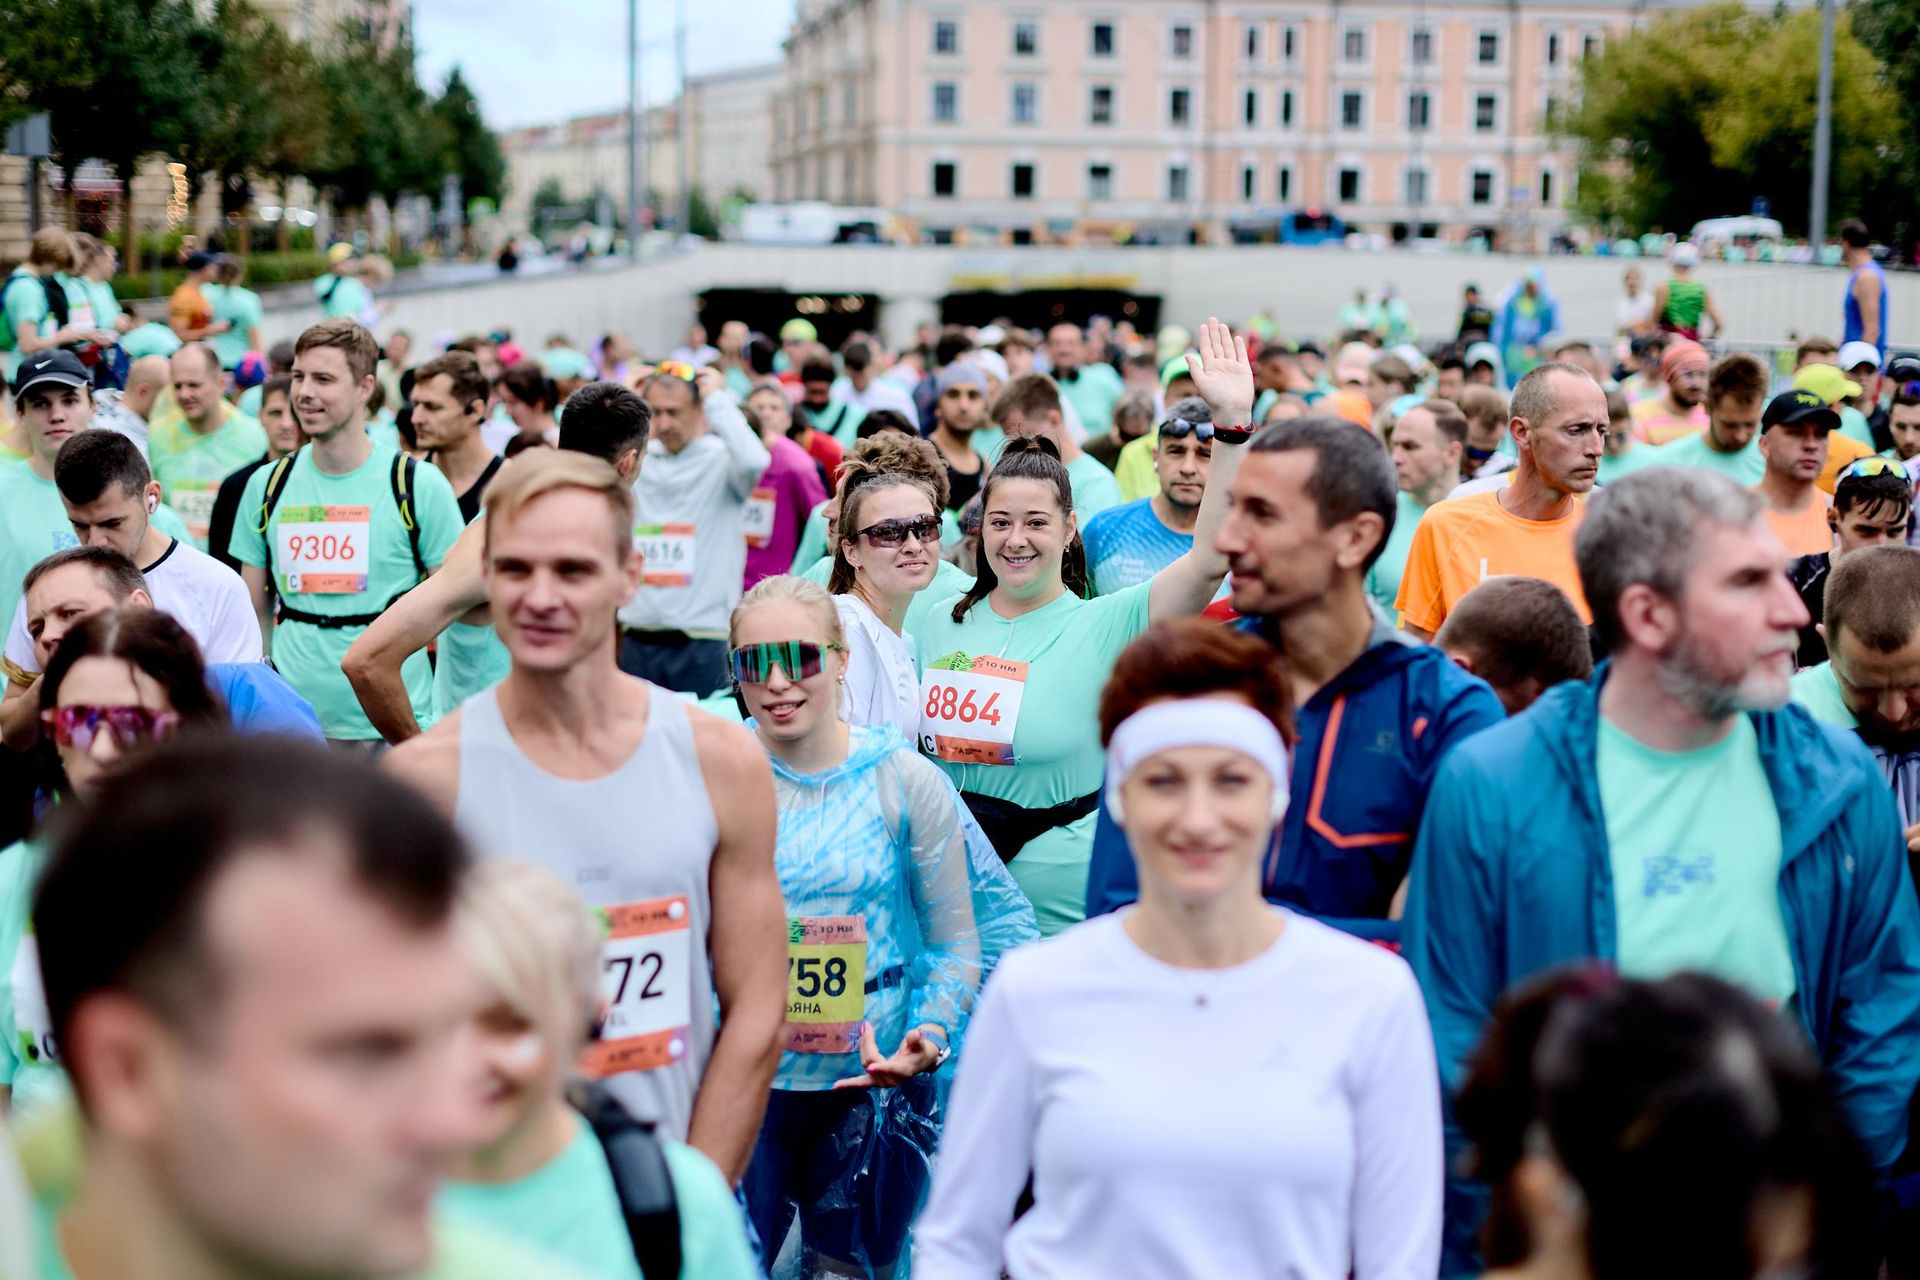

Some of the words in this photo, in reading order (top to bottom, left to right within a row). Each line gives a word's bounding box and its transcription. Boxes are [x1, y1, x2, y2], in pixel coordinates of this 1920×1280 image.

[289, 534, 354, 561] 9306
[289, 574, 298, 589] C
[986, 661, 998, 669] 10
[925, 685, 1002, 726] 8864
[924, 735, 935, 753] C
[820, 926, 833, 934] 10
